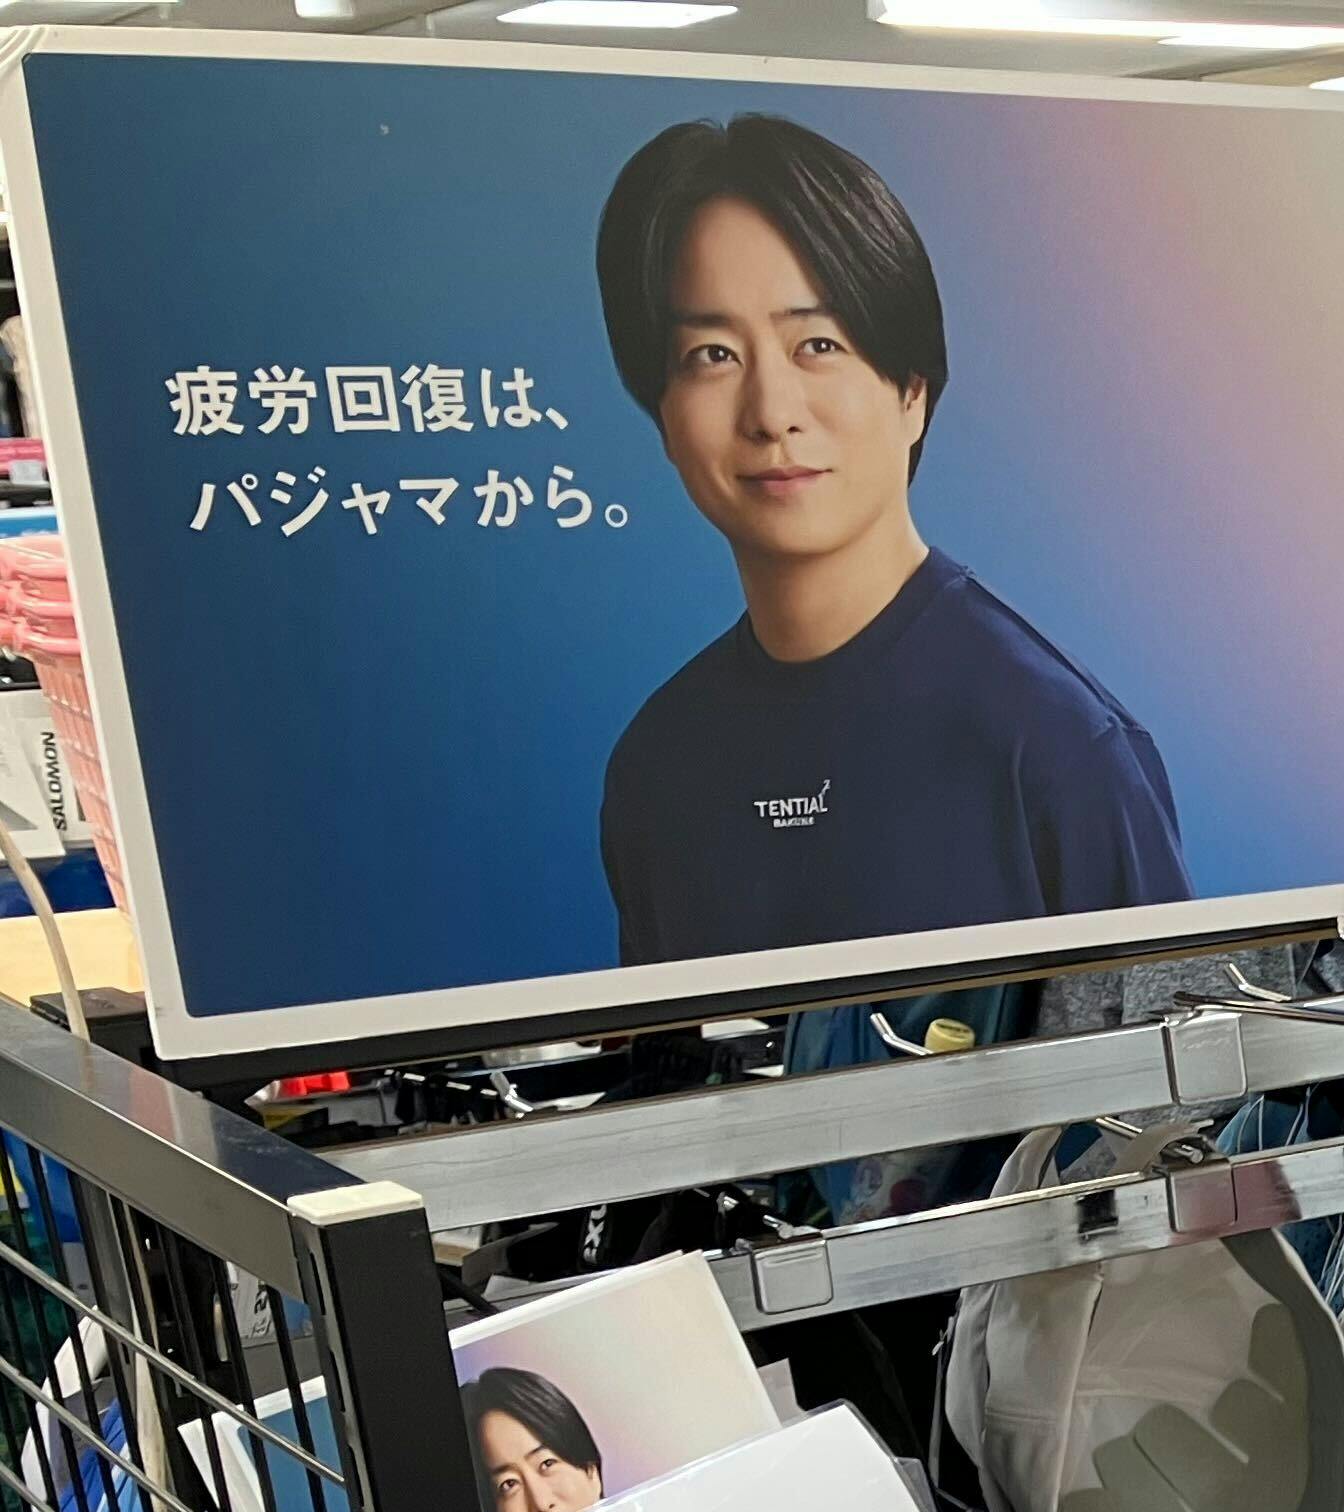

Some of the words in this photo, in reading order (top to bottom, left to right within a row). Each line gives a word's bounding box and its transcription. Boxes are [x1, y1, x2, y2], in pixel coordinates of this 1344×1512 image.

[164, 364, 569, 436] 疲労回復は、
[189, 465, 629, 537] パジャマから。
[41, 730, 69, 832] SALOMON
[753, 790, 830, 818] TENTIAL
